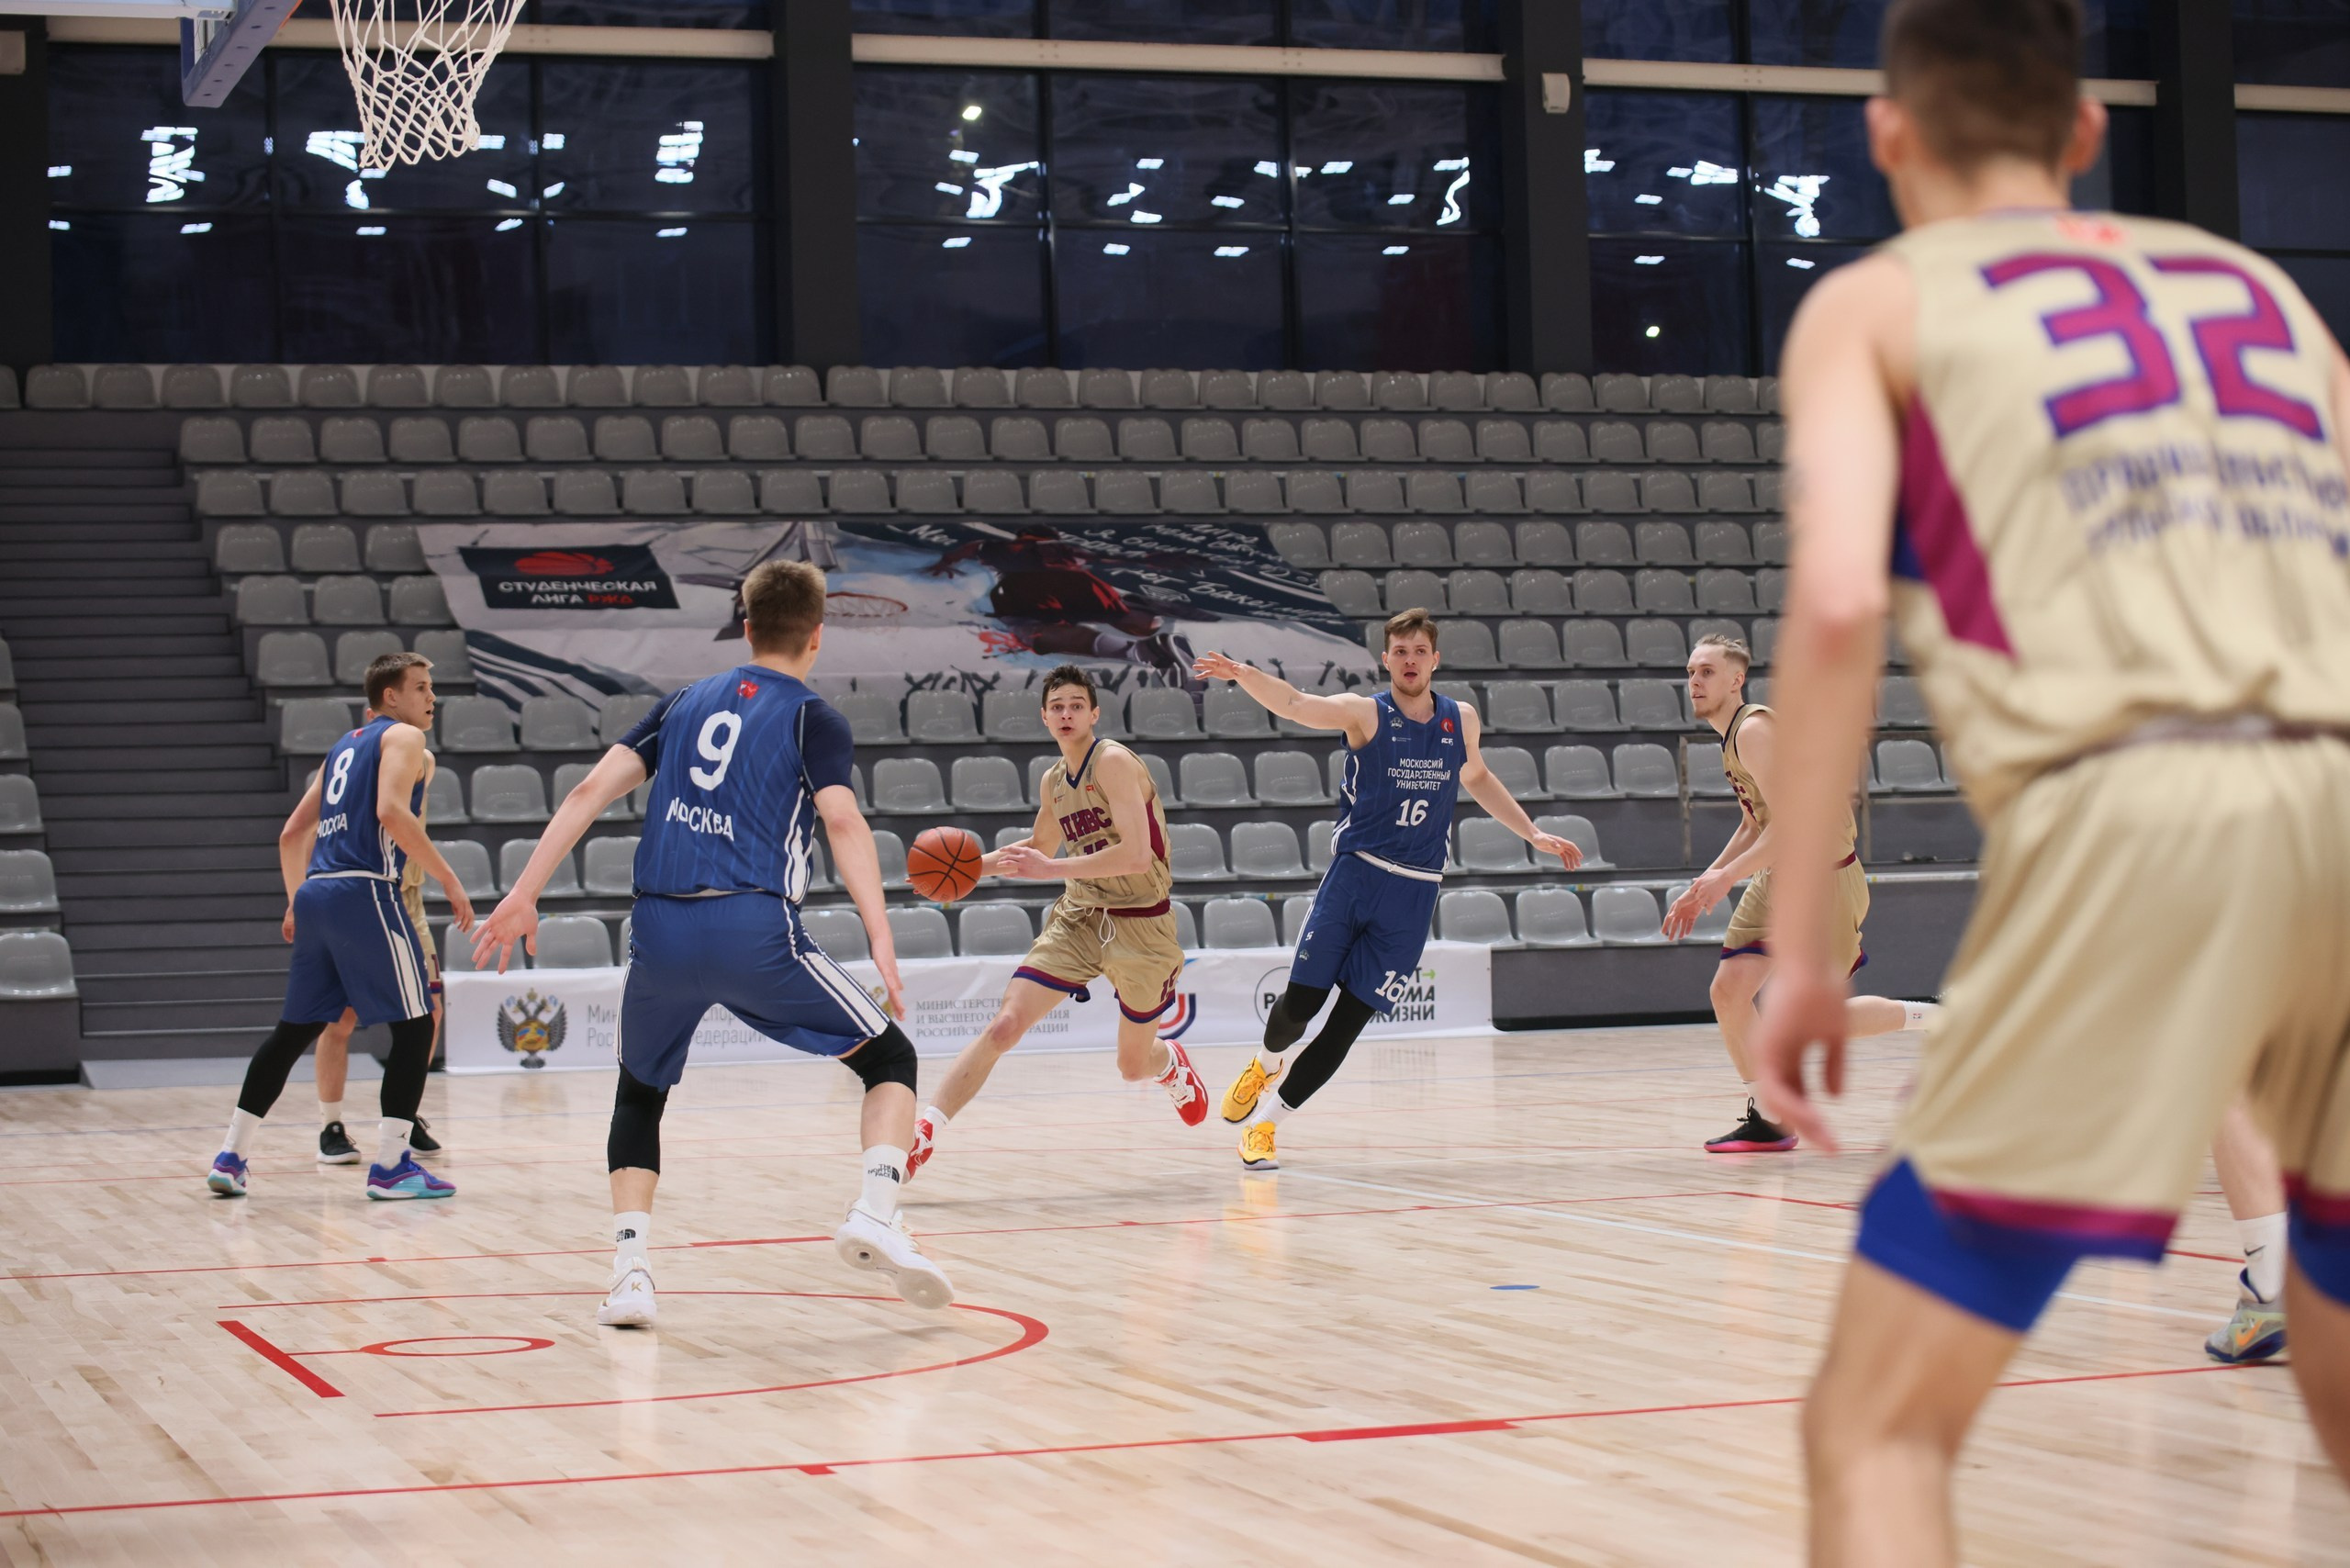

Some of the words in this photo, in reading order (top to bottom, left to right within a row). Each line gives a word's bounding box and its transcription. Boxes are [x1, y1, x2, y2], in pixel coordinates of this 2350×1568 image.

[1979, 251, 2328, 443] 32
[498, 580, 657, 593] СТУДЕНЧЕСКАЯ
[531, 593, 584, 604] ЛИГА
[689, 710, 743, 791] 9
[326, 747, 355, 805] 8
[666, 797, 734, 842] МОСКВА
[1058, 806, 1113, 843] ЦИВС
[1395, 798, 1429, 827] 16
[1374, 969, 1409, 1002] 16
[916, 998, 1002, 1011] МИНИСТЕРСТ
[928, 1012, 984, 1025] ВЫСШЕГО
[695, 1029, 767, 1048] едерации
